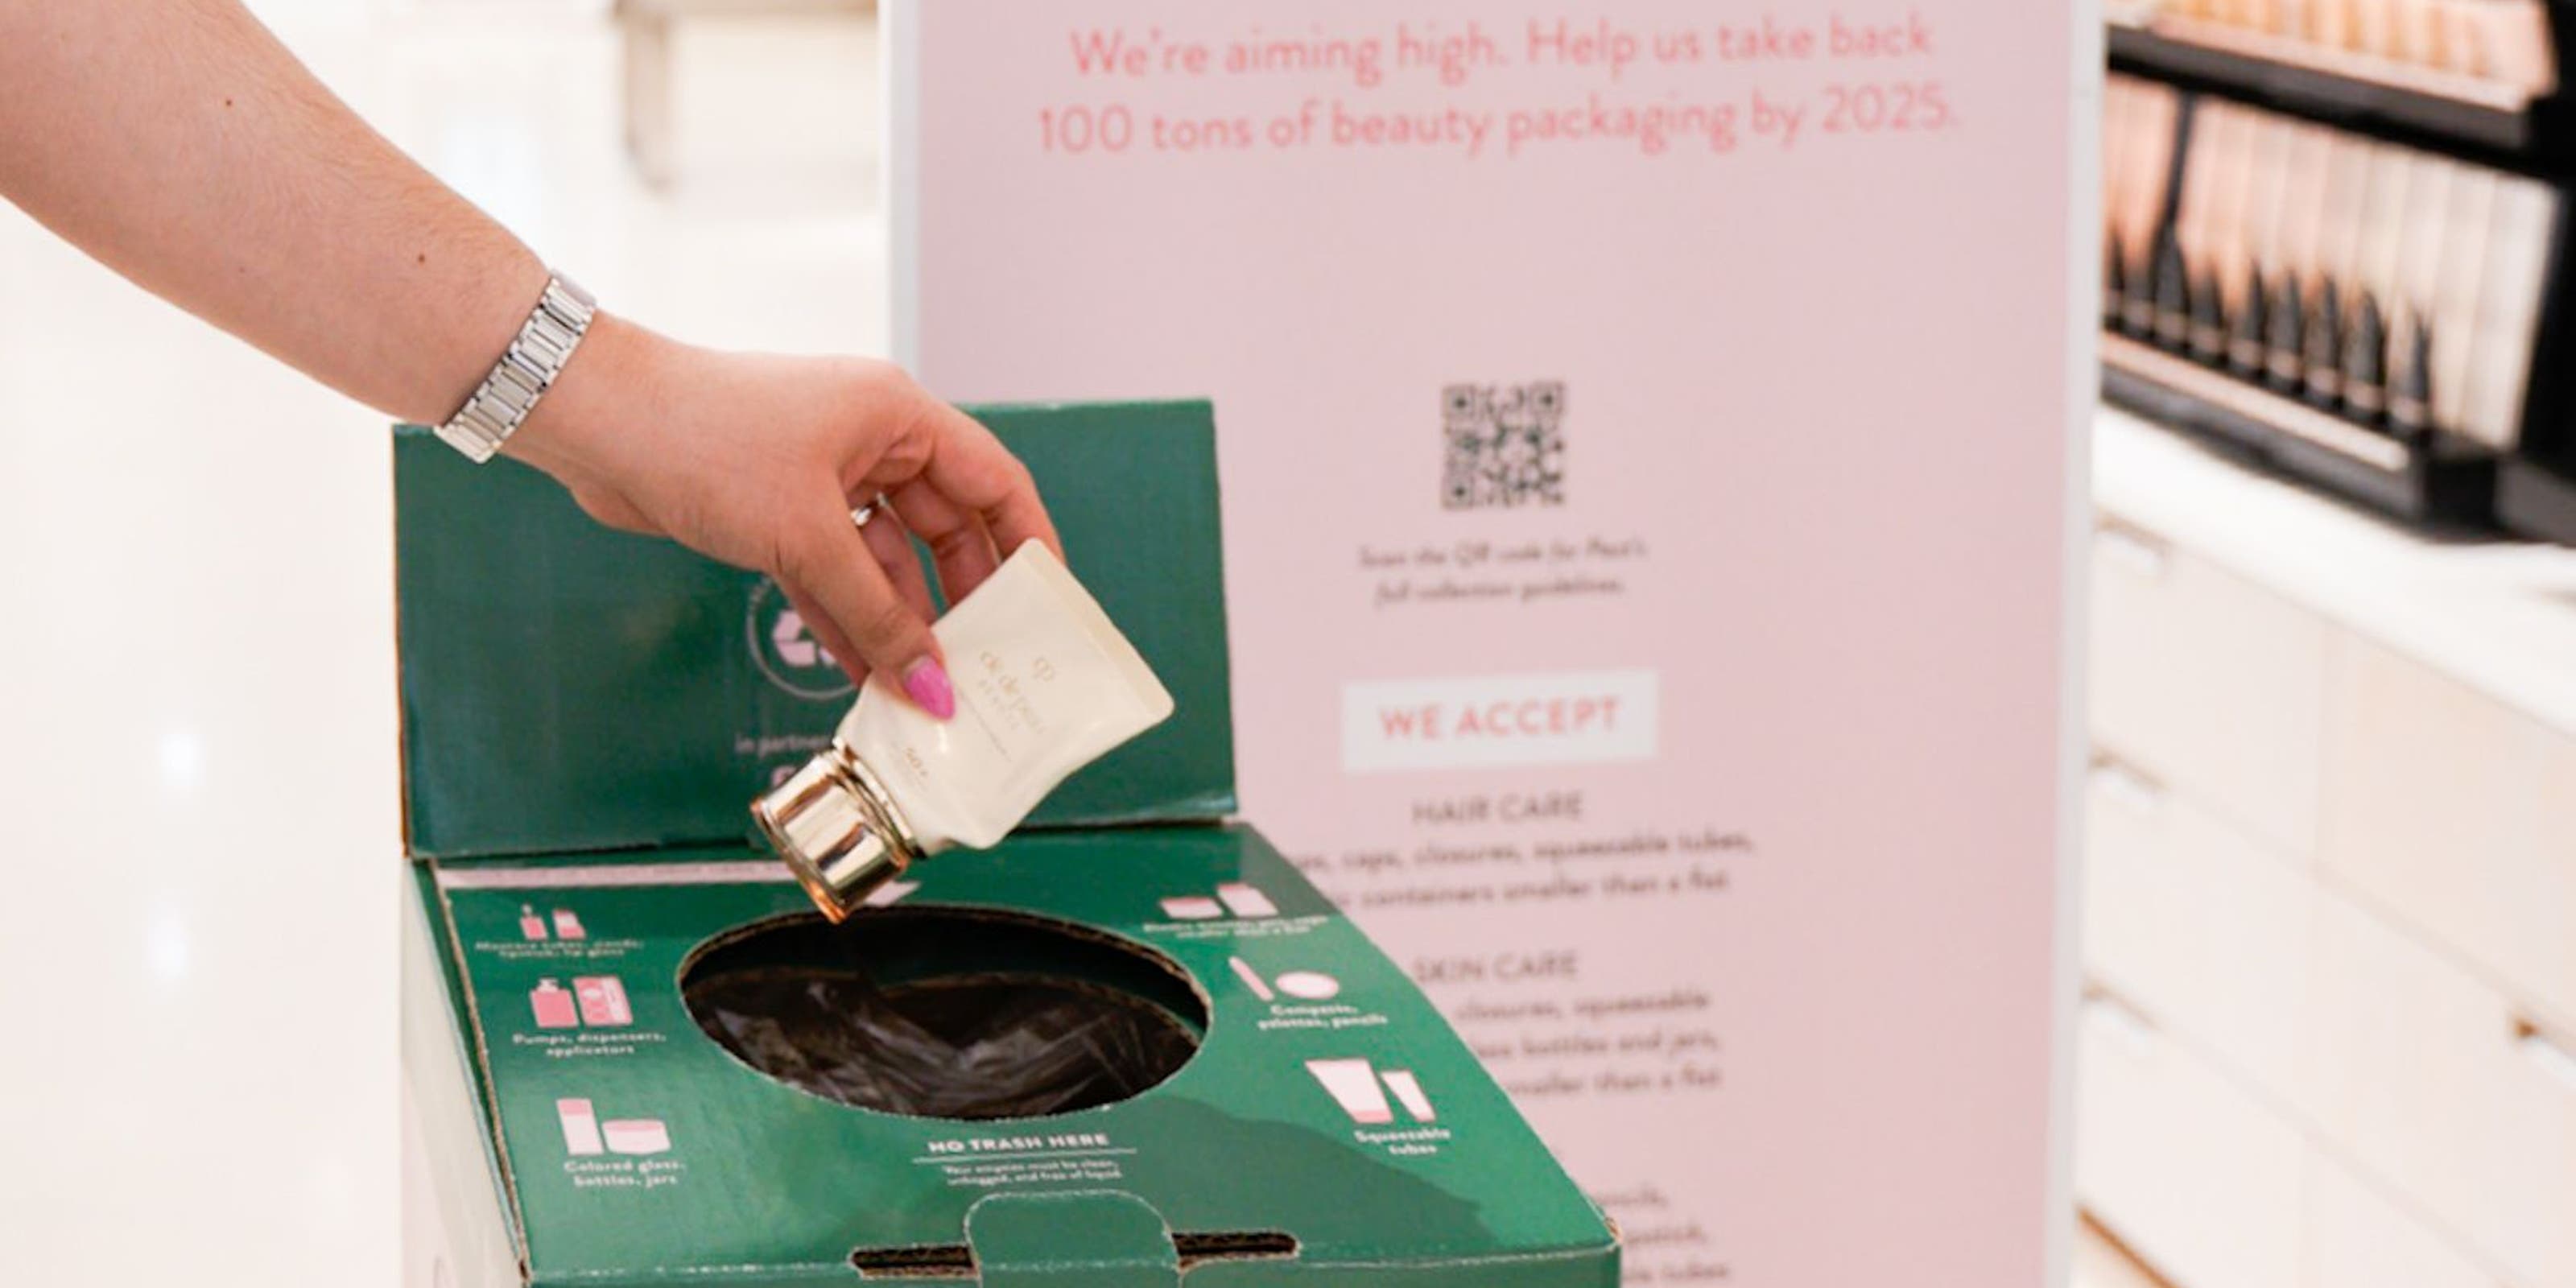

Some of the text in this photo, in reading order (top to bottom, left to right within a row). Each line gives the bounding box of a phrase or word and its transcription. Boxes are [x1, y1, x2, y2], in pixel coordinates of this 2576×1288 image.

[1070, 10, 1934, 87] We're aiming high. Help us take back
[1039, 84, 1959, 156] 100 tons of beauty packaging by 2025.
[1454, 539, 1490, 568] QR
[1380, 695, 1621, 739] WE ACCEPT
[1411, 791, 1583, 824] HAIR CARE
[1414, 950, 1577, 982] SKIN CARE
[513, 1033, 572, 1046] Pumps,
[546, 1045, 634, 1058] applicators
[927, 1132, 1110, 1153] NO TRASH HERE
[1354, 1128, 1451, 1146] Squeezable
[1388, 1141, 1438, 1156] tubes
[564, 1159, 633, 1173] Colored
[646, 1174, 678, 1188] jars
